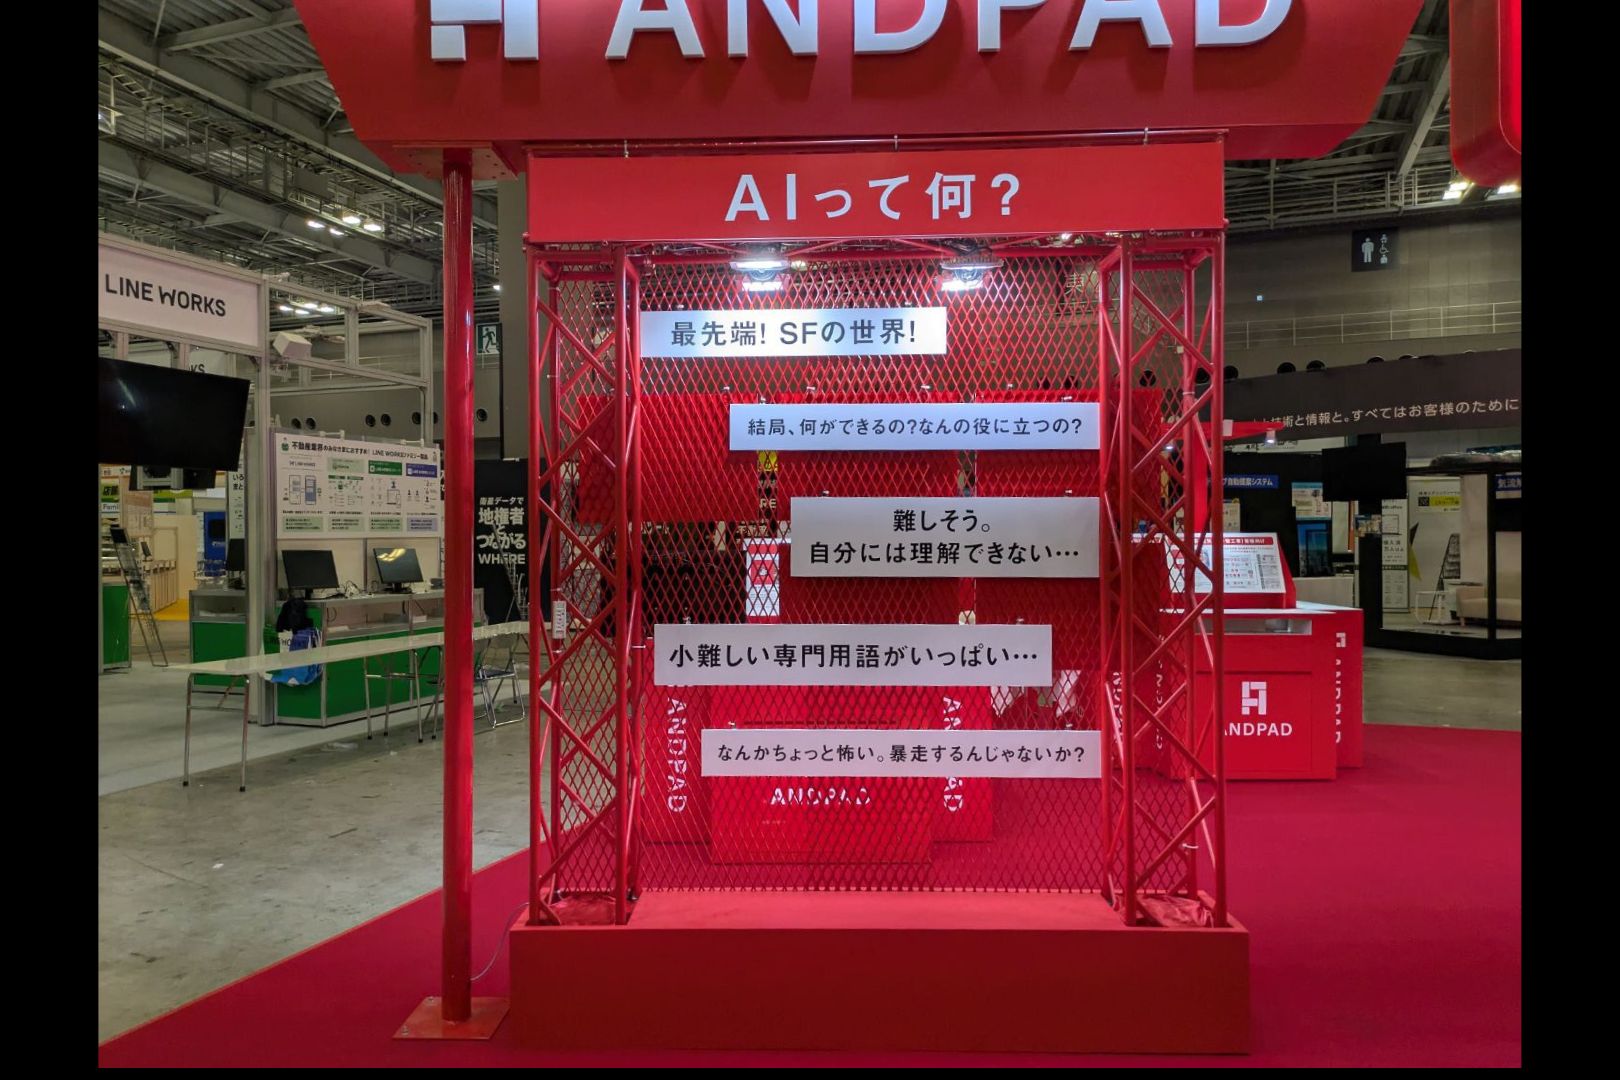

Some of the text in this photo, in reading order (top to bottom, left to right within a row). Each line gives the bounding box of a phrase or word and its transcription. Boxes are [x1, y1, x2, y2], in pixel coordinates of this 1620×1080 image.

[724, 171, 1021, 222] AIって何?
[105, 273, 226, 318] LINE WORKS
[671, 318, 917, 346] 最先端! SFの世界!
[747, 415, 1083, 437] 結局、何ができるの?なんの役に立つの?
[893, 510, 991, 533] 難しそう。
[1225, 722, 1293, 737] NDPAD
[717, 744, 1086, 764] なんかちょっと怖い。暴走するんじゃないか?
